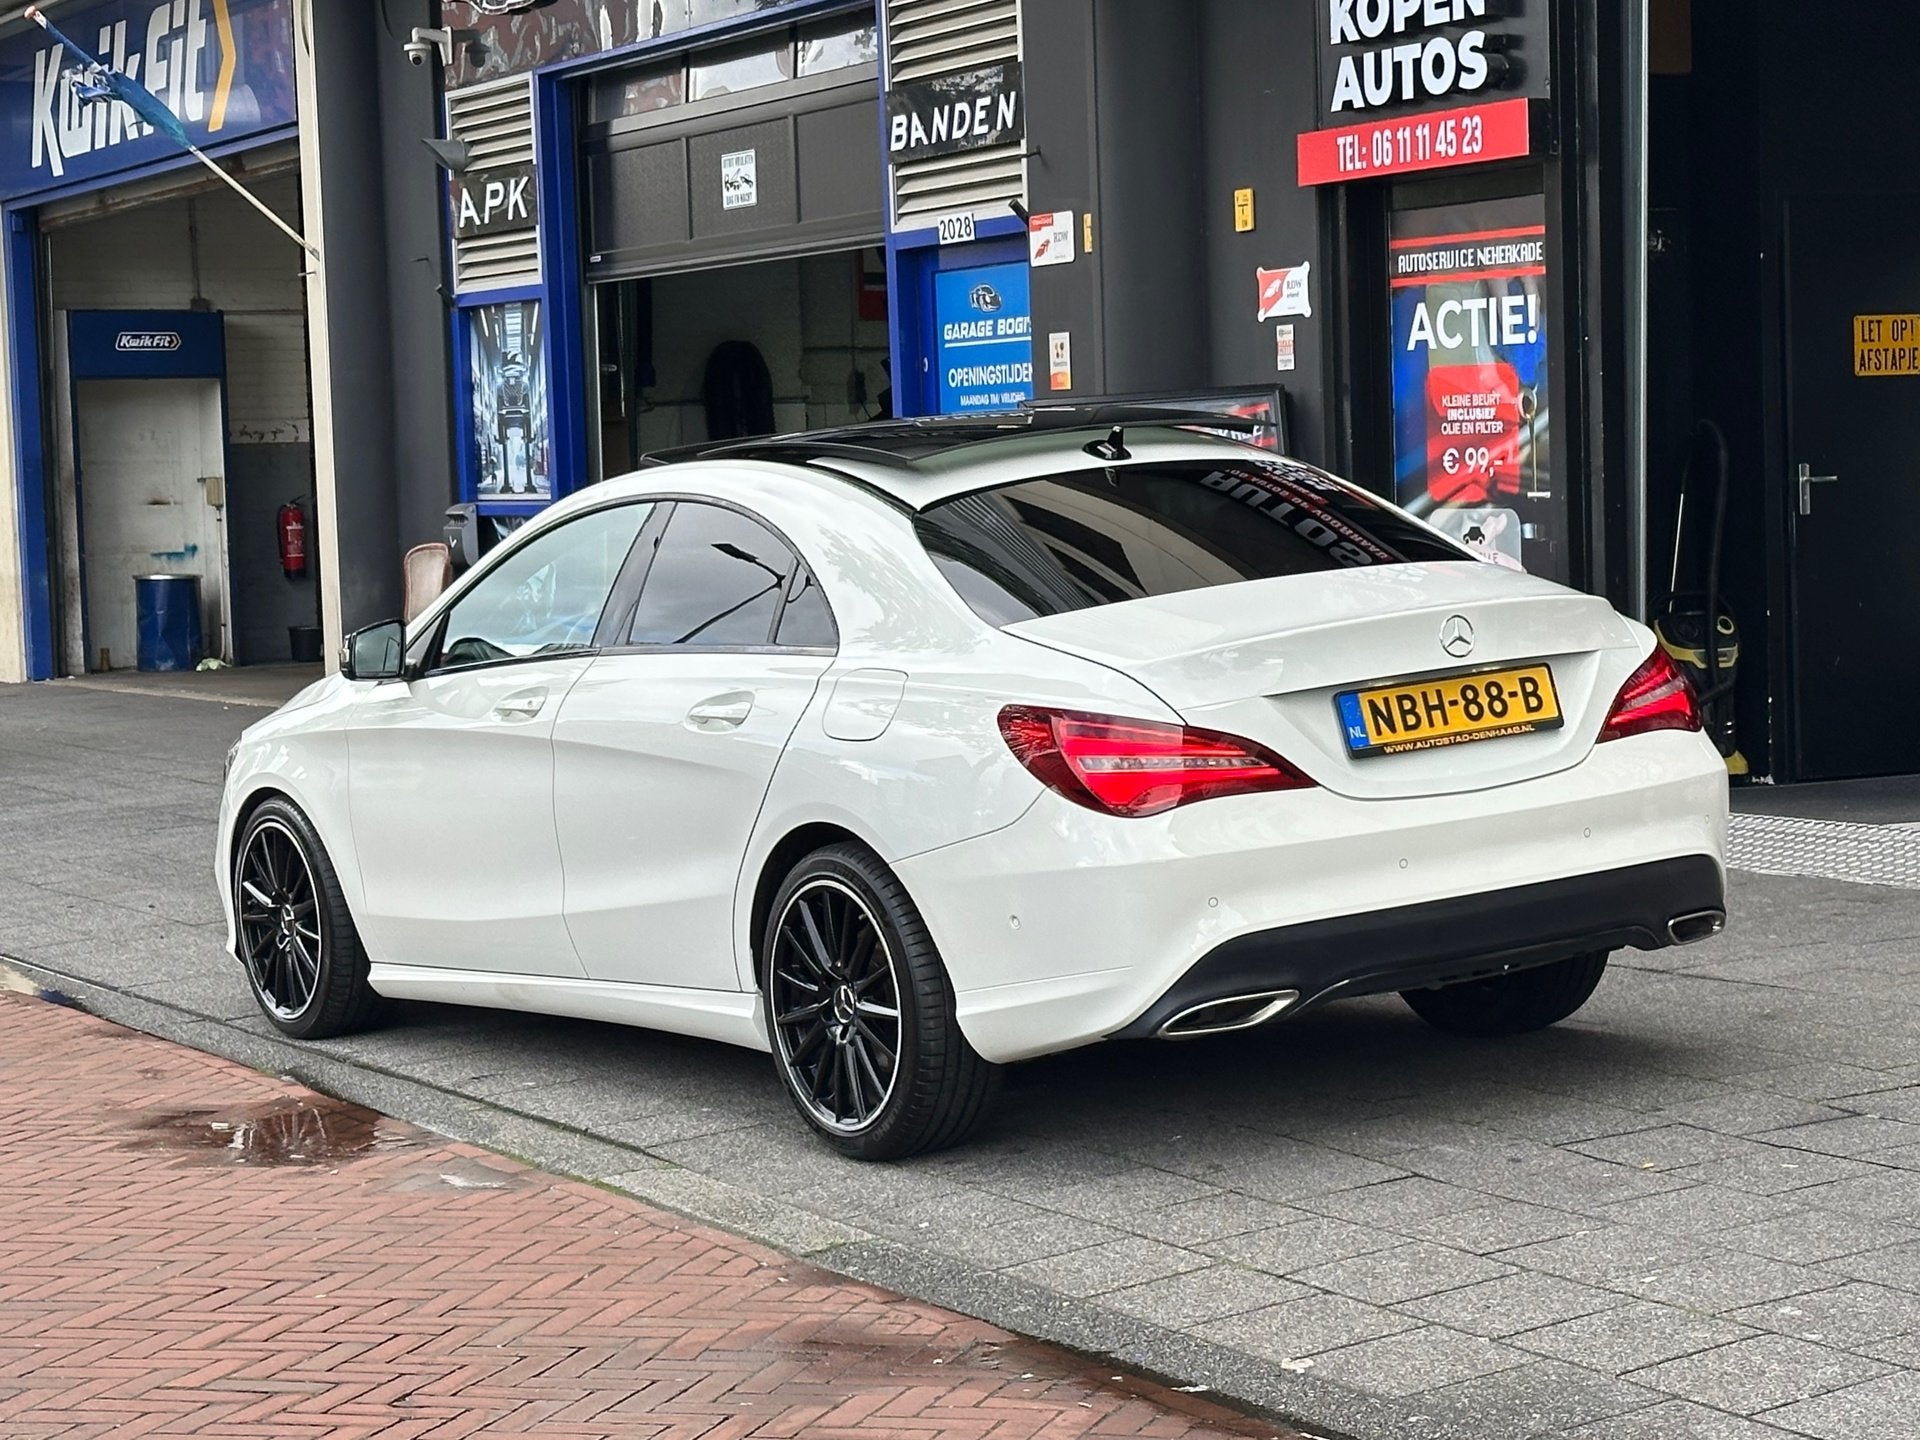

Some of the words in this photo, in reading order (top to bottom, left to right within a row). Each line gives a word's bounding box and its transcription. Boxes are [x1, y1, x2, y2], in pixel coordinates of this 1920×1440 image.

[1330, 0, 1486, 45] KOP
[1330, 30, 1488, 113] AUTOS
[890, 91, 1016, 151] BANDEN
[1337, 135, 1367, 173] TEL:
[1372, 129, 1393, 168] 06
[1397, 126, 1411, 164] 11
[1416, 123, 1431, 160] 11
[1435, 119, 1457, 158] 45
[1462, 115, 1482, 154] 23
[459, 176, 529, 228] APK
[939, 216, 973, 240] 2028
[1398, 249, 1475, 273] AUTOSERVICE
[1477, 242, 1543, 266] NEHERKADE
[944, 320, 993, 340] GARAGE
[997, 316, 1032, 335] BOGI'
[1407, 294, 1537, 351] ACTIE!
[1861, 320, 1882, 343] LET
[1892, 319, 1914, 341] OP!
[1859, 347, 1919, 371] AFSTAPJE
[1442, 394, 1471, 407] KLEINE
[1472, 393, 1501, 406] BEURT
[1447, 407, 1497, 420] INCLUSIEF
[1441, 422, 1461, 435] OLIE
[1462, 422, 1474, 434] EN
[1475, 421, 1503, 434] FILTER
[1442, 448, 1459, 475] €
[1367, 676, 1544, 737] NBH-88-B
[1349, 726, 1366, 739] NL
[1384, 724, 1535, 753] WWW.AUTOSTAD-DENHAAG.NL
